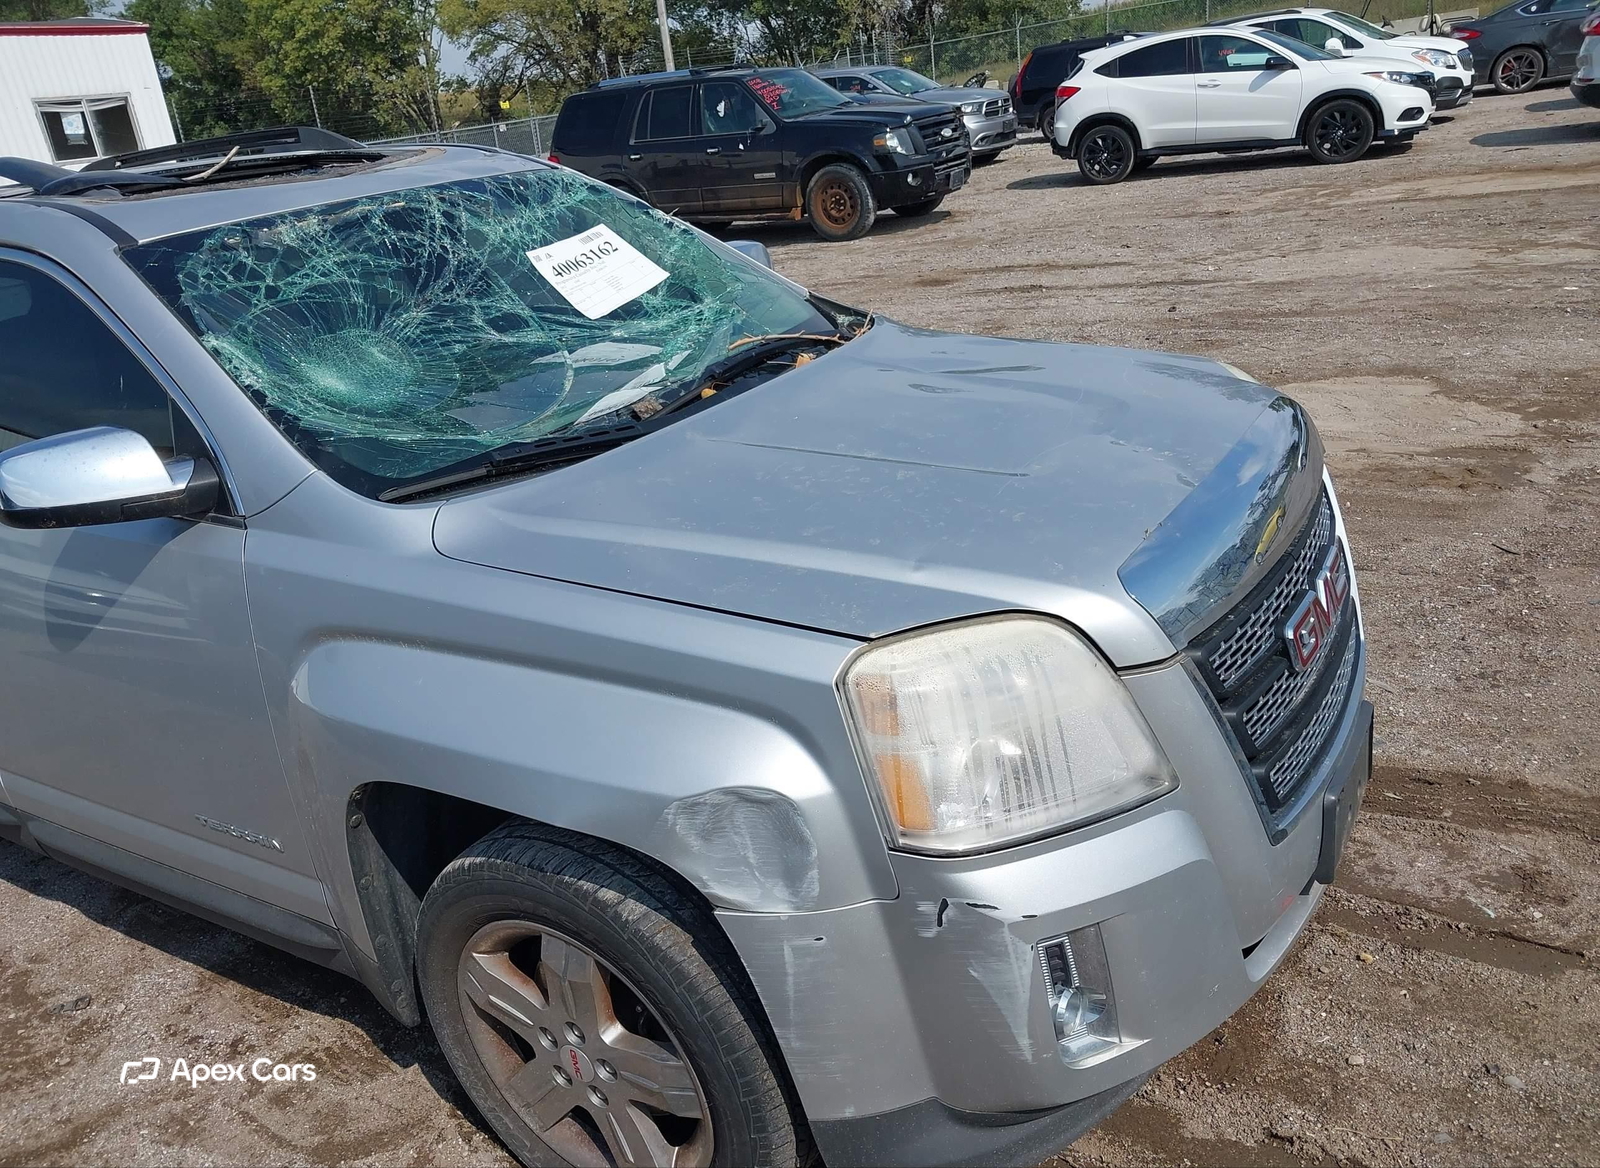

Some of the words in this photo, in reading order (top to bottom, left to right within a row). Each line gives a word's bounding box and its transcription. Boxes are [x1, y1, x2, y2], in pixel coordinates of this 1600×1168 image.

[551, 241, 619, 278] 40063162
[1283, 545, 1349, 672] GMC
[194, 812, 285, 853] TERRAIN
[569, 1049, 583, 1080] GMC
